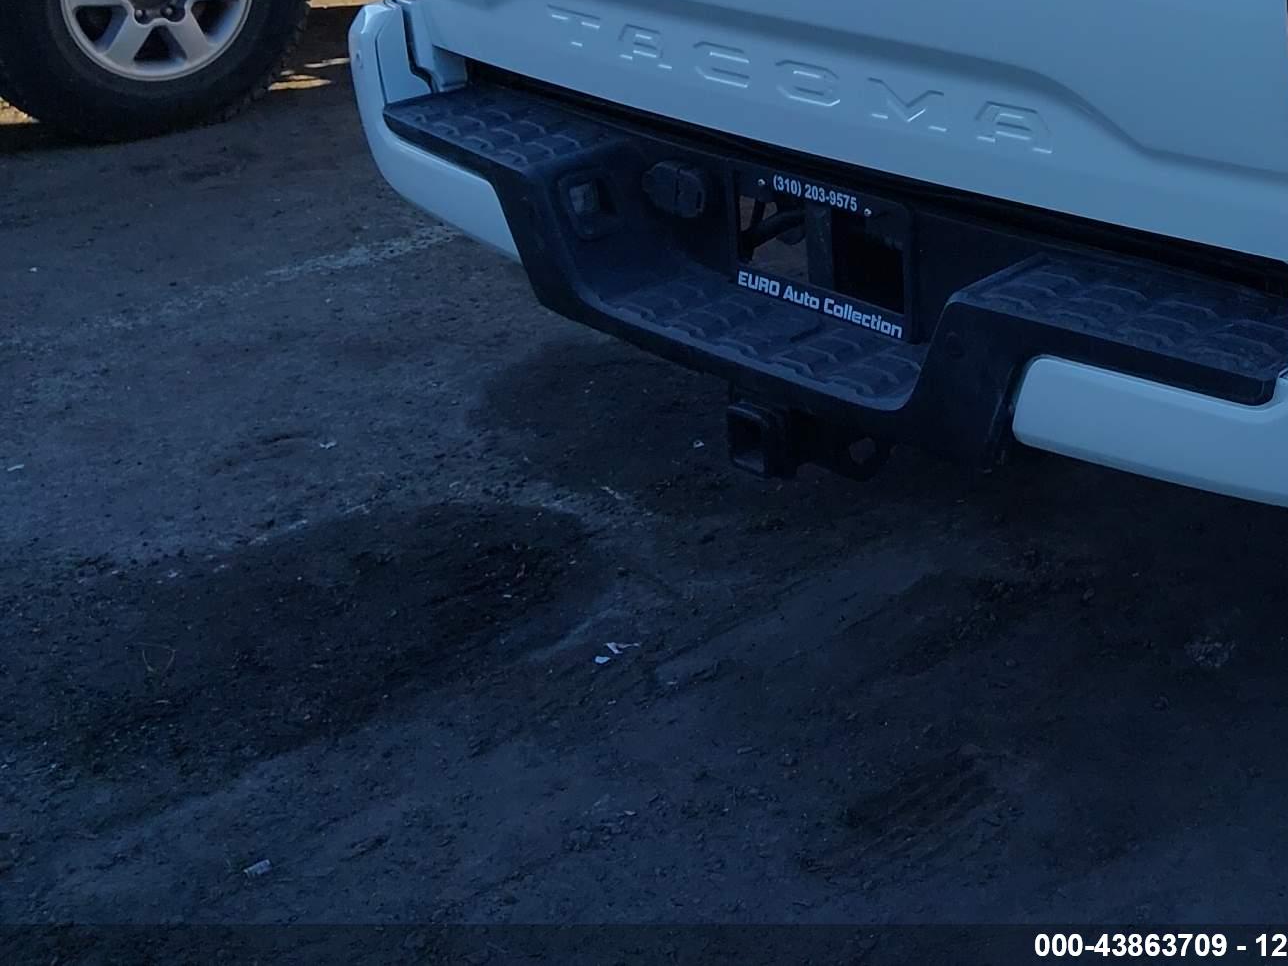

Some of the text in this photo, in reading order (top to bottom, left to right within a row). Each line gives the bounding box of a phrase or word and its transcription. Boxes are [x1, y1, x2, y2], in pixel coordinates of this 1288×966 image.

[547, 4, 1053, 154] TACOMA
[772, 173, 858, 212] (310) 203-9575
[737, 270, 903, 339] EURO Auto Collection
